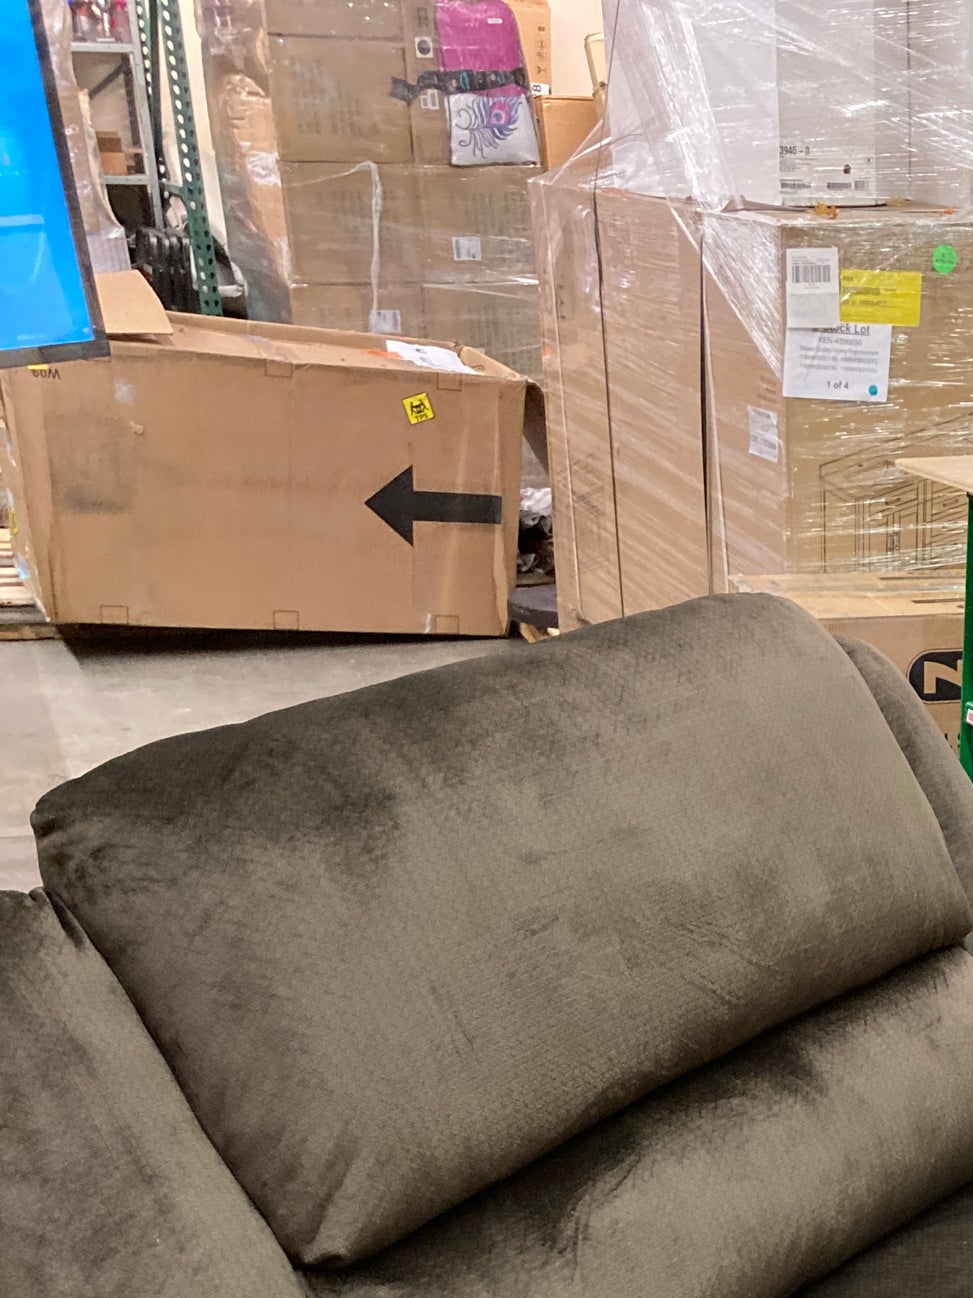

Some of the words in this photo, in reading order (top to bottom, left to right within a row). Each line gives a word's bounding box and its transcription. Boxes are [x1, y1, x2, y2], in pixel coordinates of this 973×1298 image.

[854, 324, 870, 335] Lot
[833, 380, 843, 389] of
[843, 381, 849, 390] 4
